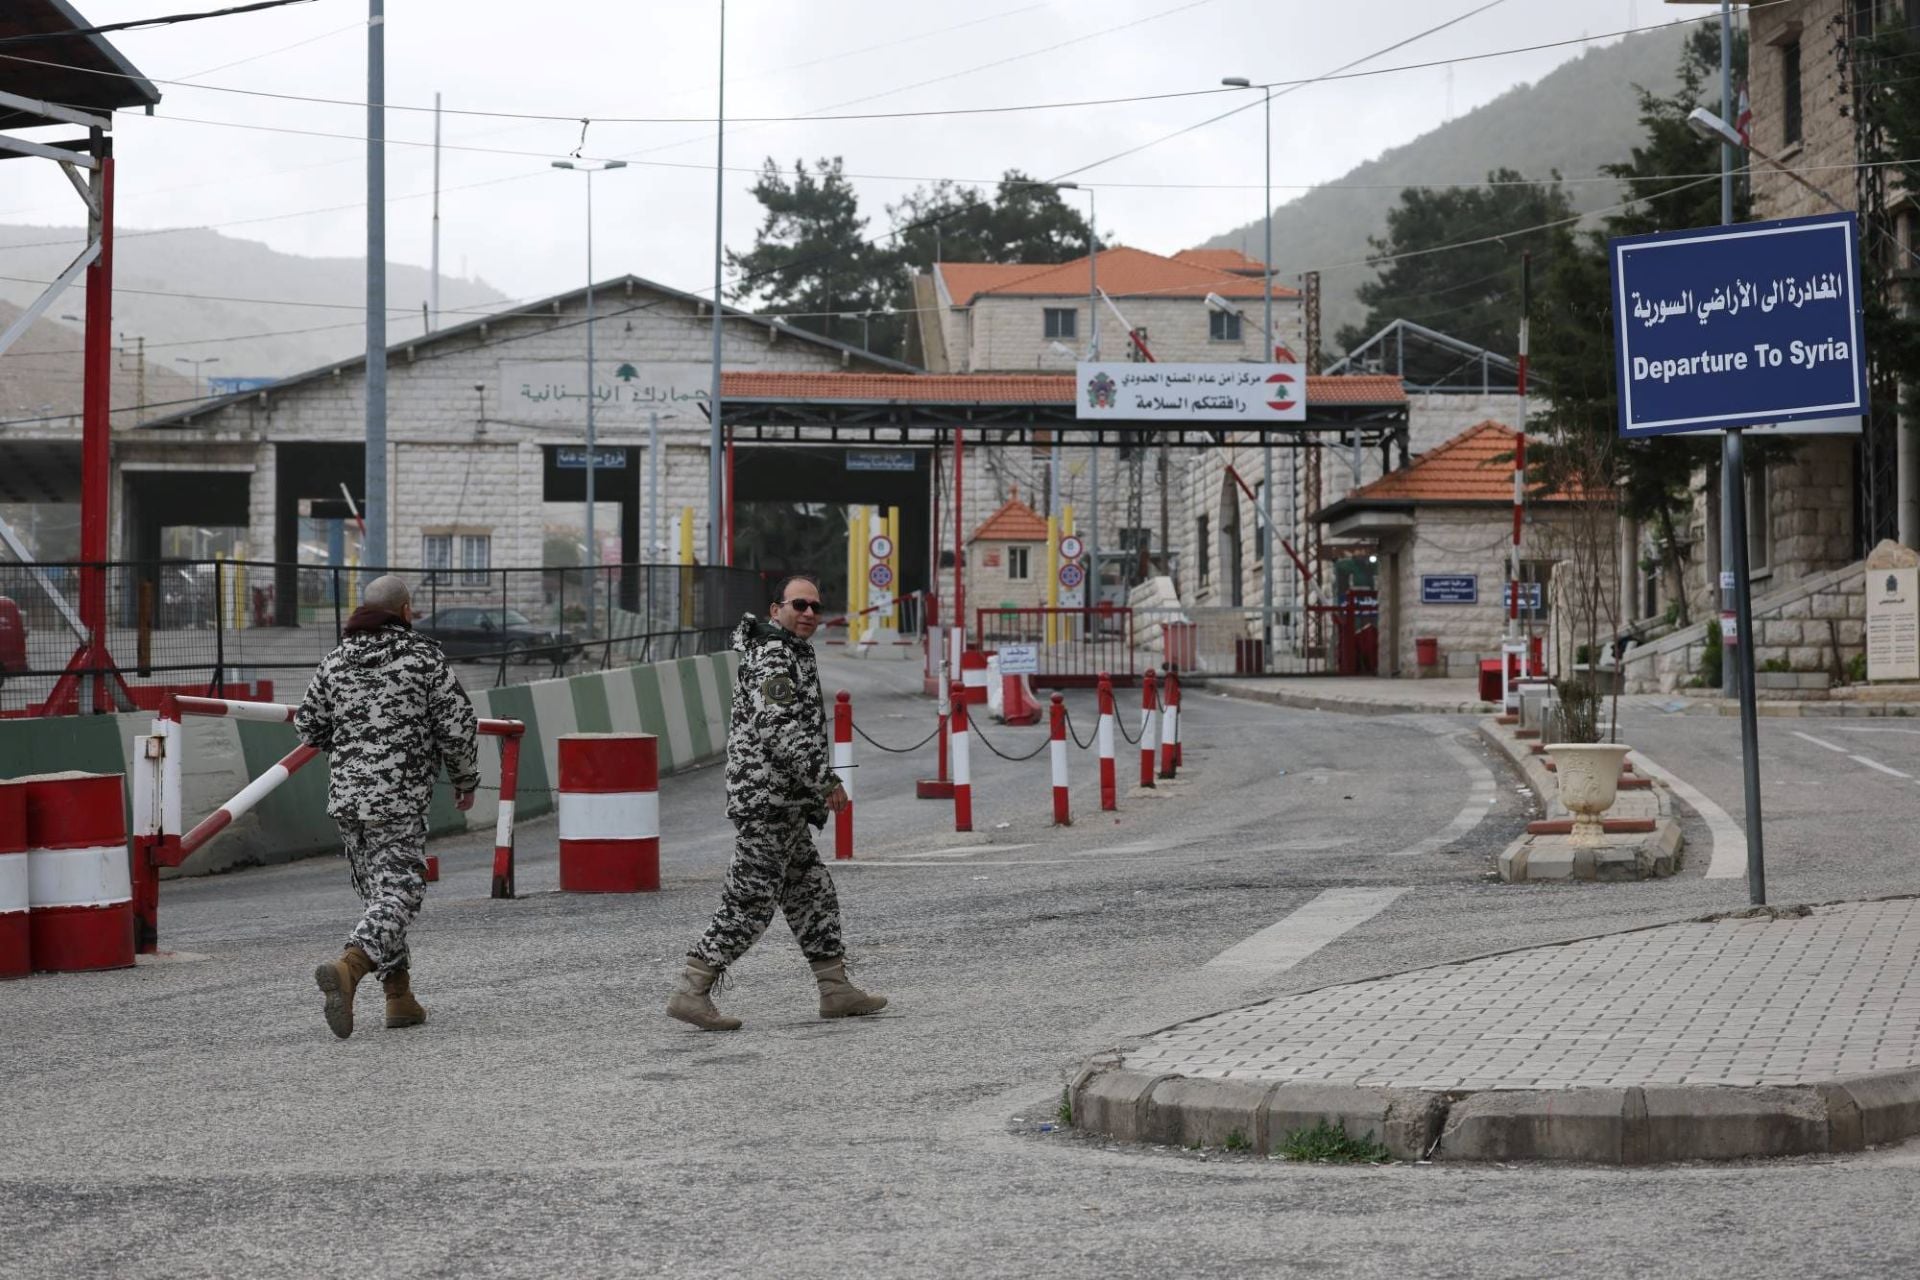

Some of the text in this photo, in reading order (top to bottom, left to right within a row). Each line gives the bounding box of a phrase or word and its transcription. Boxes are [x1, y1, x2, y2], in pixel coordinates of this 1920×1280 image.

[1631, 272, 1843, 328] المغادرة الى الأراضي السورية
[1633, 337, 1849, 384] Departure To Syria
[1121, 373, 1164, 387] الحدودي
[1197, 372, 1216, 386] عام
[1237, 372, 1261, 387] مركز
[1135, 394, 1247, 414] رافقتكم السلامة
